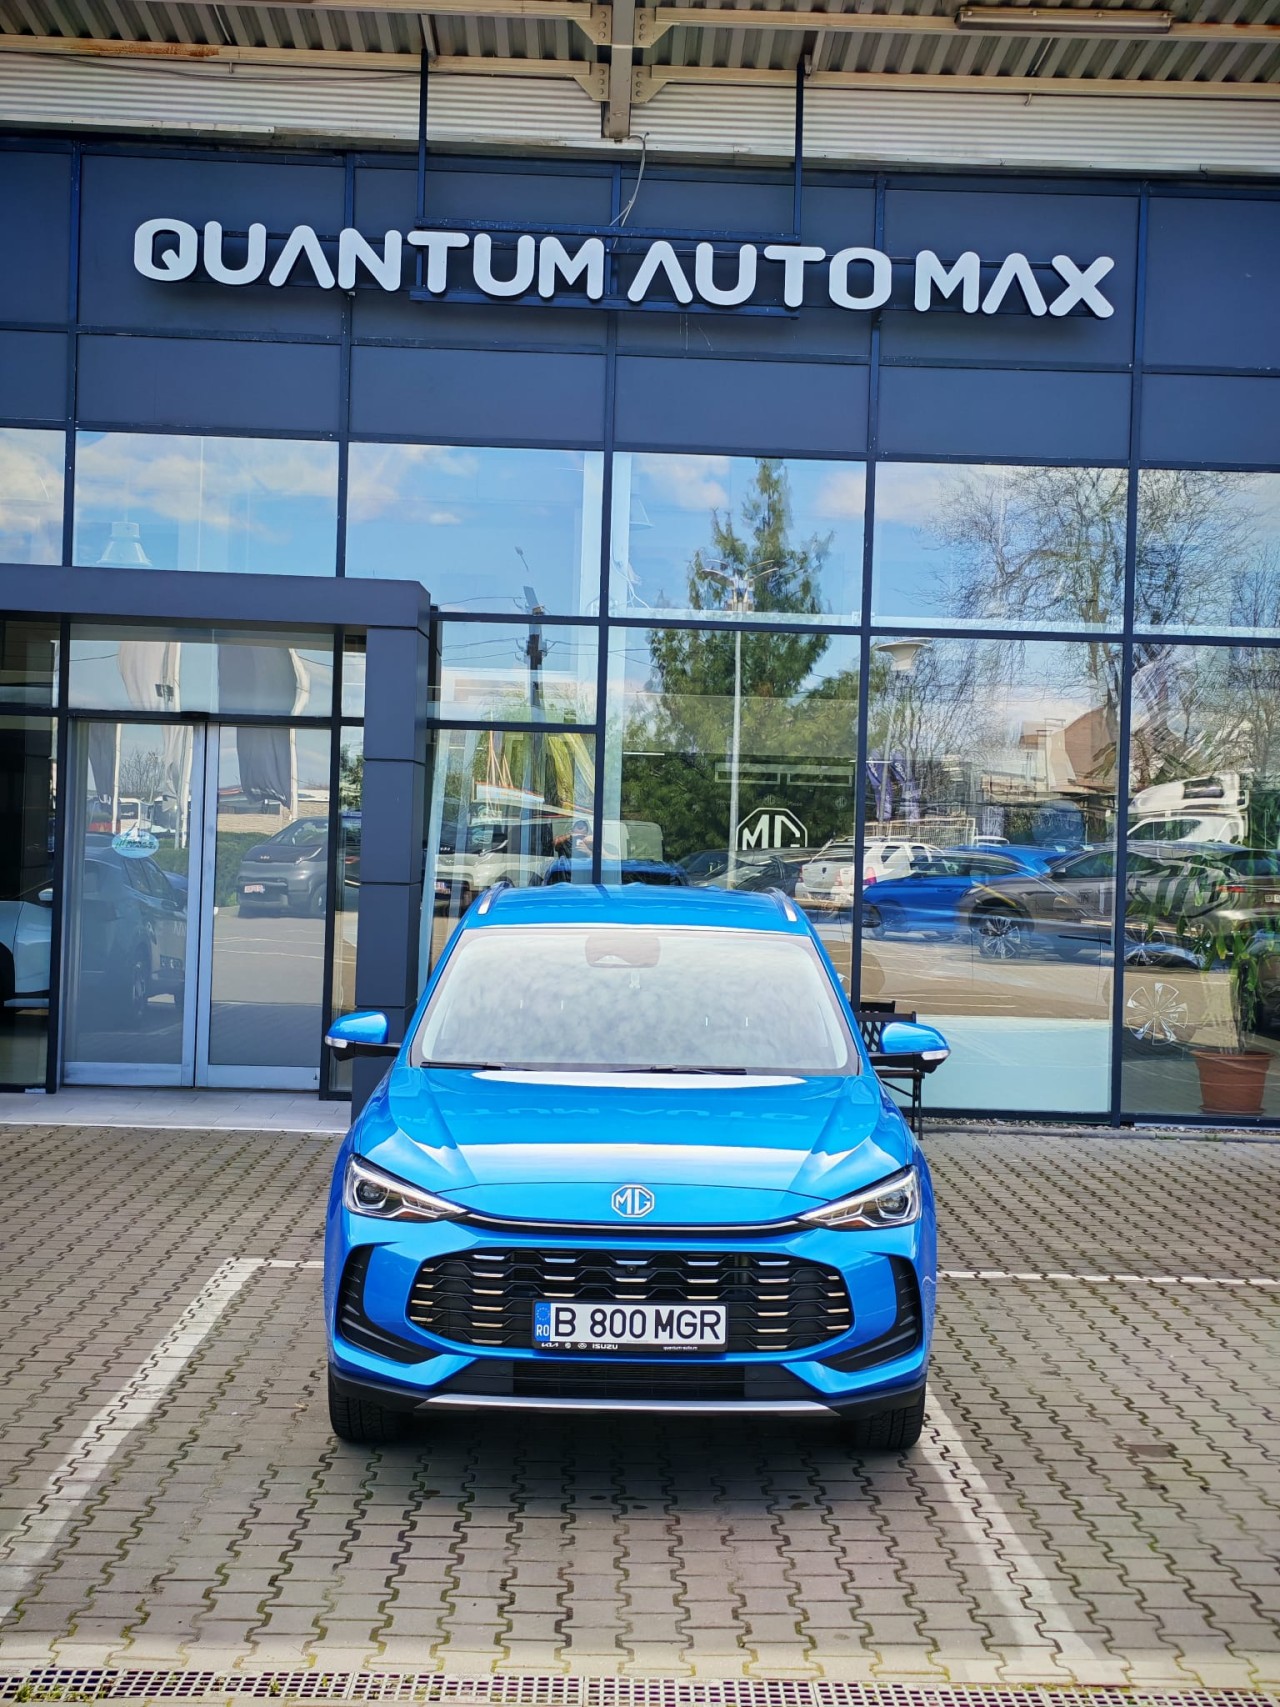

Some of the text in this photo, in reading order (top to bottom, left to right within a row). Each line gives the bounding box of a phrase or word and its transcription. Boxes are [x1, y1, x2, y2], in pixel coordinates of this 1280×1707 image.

[134, 218, 1115, 318] QUANTUM AUTO MAX
[615, 1188, 651, 1215] MG
[536, 1324, 550, 1337] RO
[554, 1307, 722, 1340] B 800 MGR
